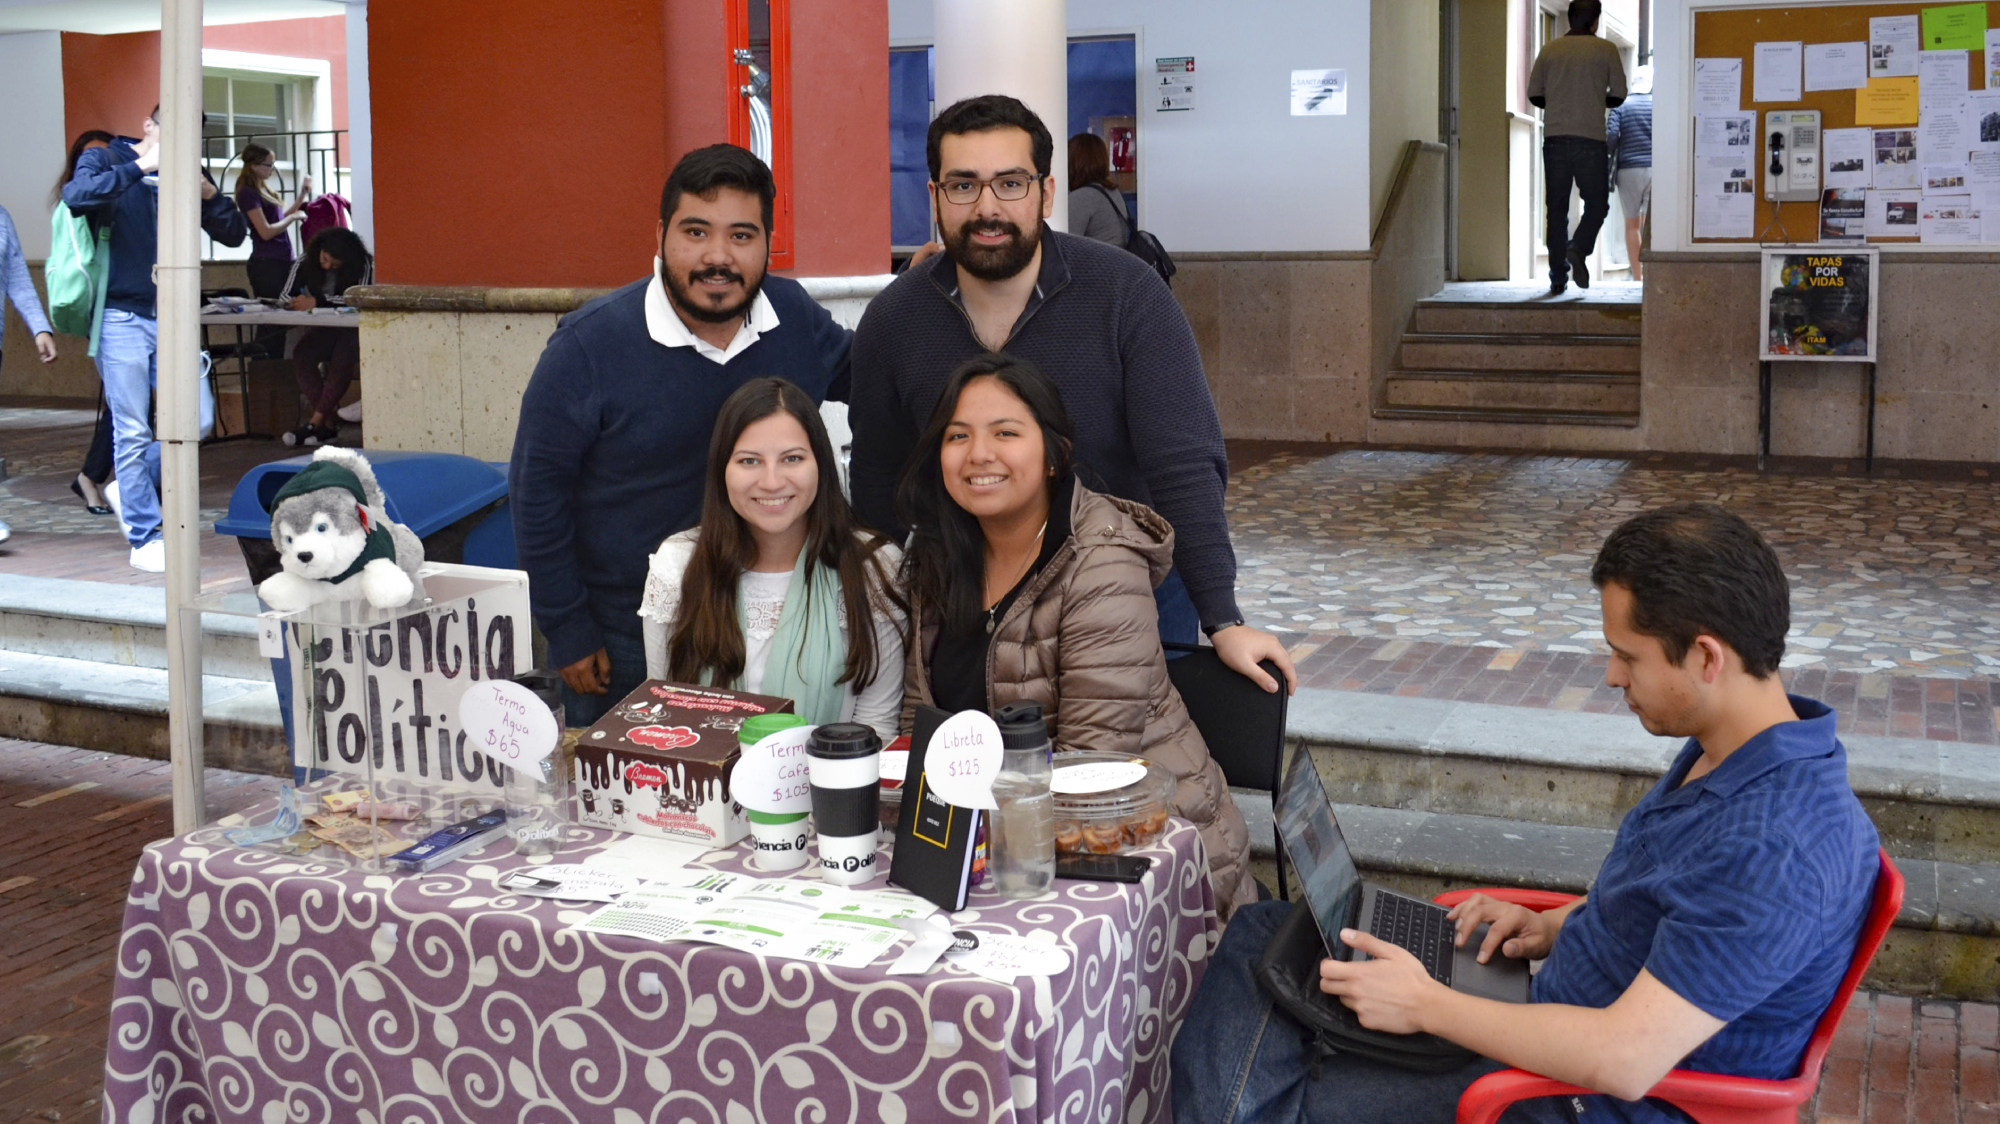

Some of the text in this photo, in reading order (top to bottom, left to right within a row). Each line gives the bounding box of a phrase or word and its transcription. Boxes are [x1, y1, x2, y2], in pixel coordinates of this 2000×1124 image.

[1296, 78, 1338, 86] SANITARIOS
[1806, 257, 1843, 267] TAPAS
[1815, 267, 1839, 277] POR
[1809, 277, 1845, 287] VIDAS
[492, 686, 526, 715] Termo
[502, 711, 529, 738] Agua
[485, 728, 521, 759] $65
[638, 729, 691, 747] Bremen
[943, 726, 984, 749] Libreta
[765, 742, 806, 758] Term
[631, 766, 663, 783] Bremen
[949, 758, 980, 777] $125
[771, 783, 810, 801] $105
[548, 866, 618, 878] Sticker
